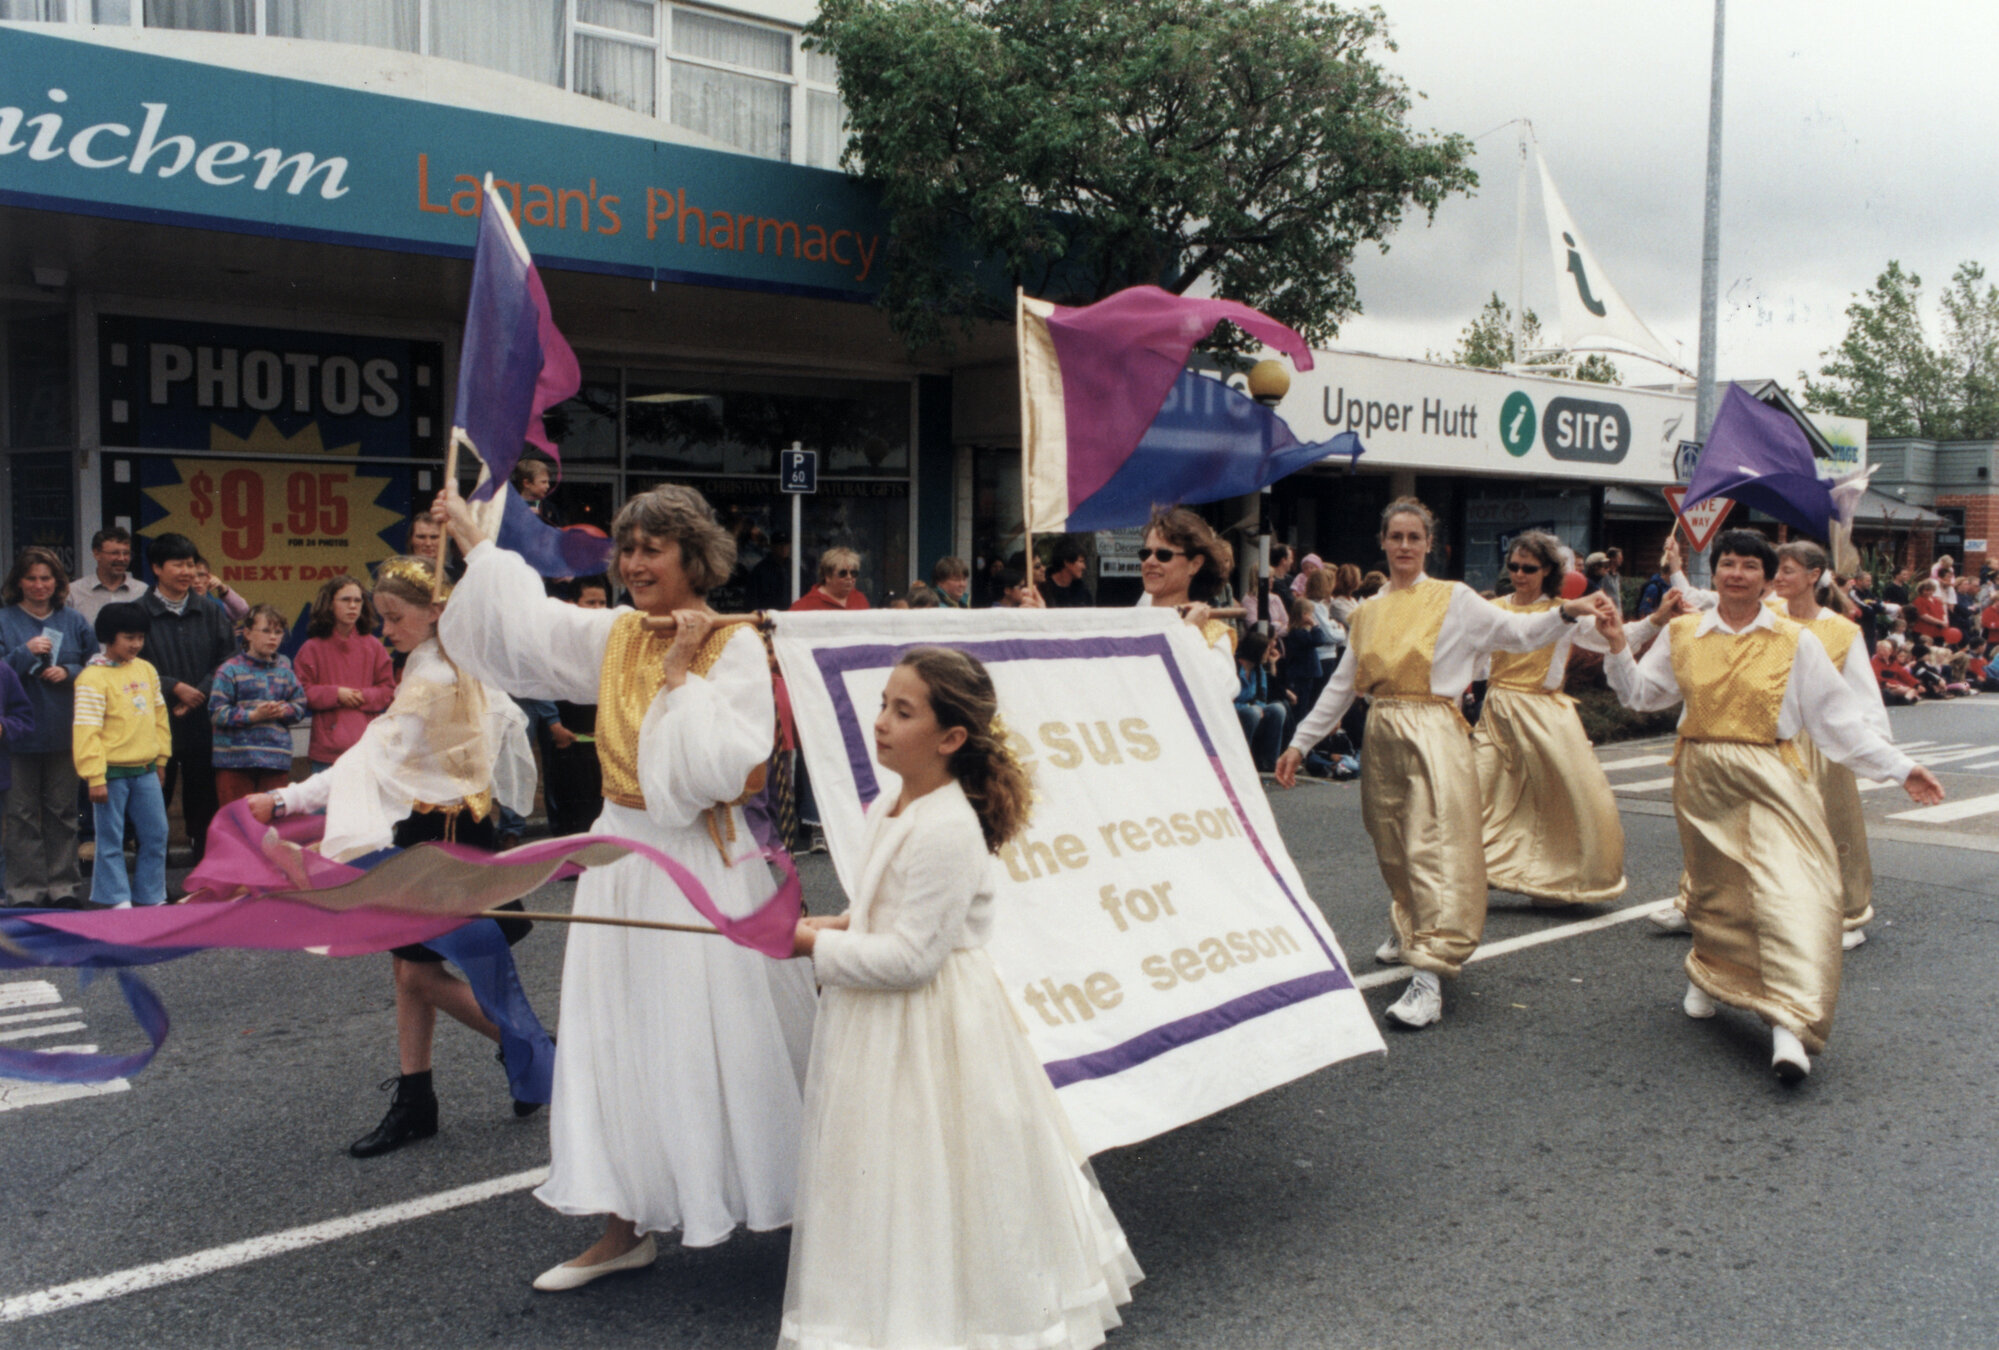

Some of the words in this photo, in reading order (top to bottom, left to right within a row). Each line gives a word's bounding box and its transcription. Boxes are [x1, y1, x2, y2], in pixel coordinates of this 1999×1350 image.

[646, 186, 880, 283] Pharmacy
[149, 342, 400, 418] PHOTOS
[1321, 385, 1413, 439] Upper
[1421, 397, 1478, 439] Hutt
[792, 471, 806, 483] 60
[793, 453, 804, 469] P
[190, 468, 349, 561] $9.95
[1688, 498, 1717, 512] IVE
[1691, 516, 1710, 527] WAY
[288, 539, 304, 547] FOR
[318, 539, 349, 547] PHOTOS
[223, 566, 294, 581] NEXT
[299, 566, 350, 581] DAY
[1004, 716, 1162, 777] esus
[998, 832, 1090, 883] the
[1098, 806, 1243, 858] reason
[1099, 880, 1178, 933] for
[1023, 971, 1125, 1027] the
[1141, 924, 1301, 991] season
